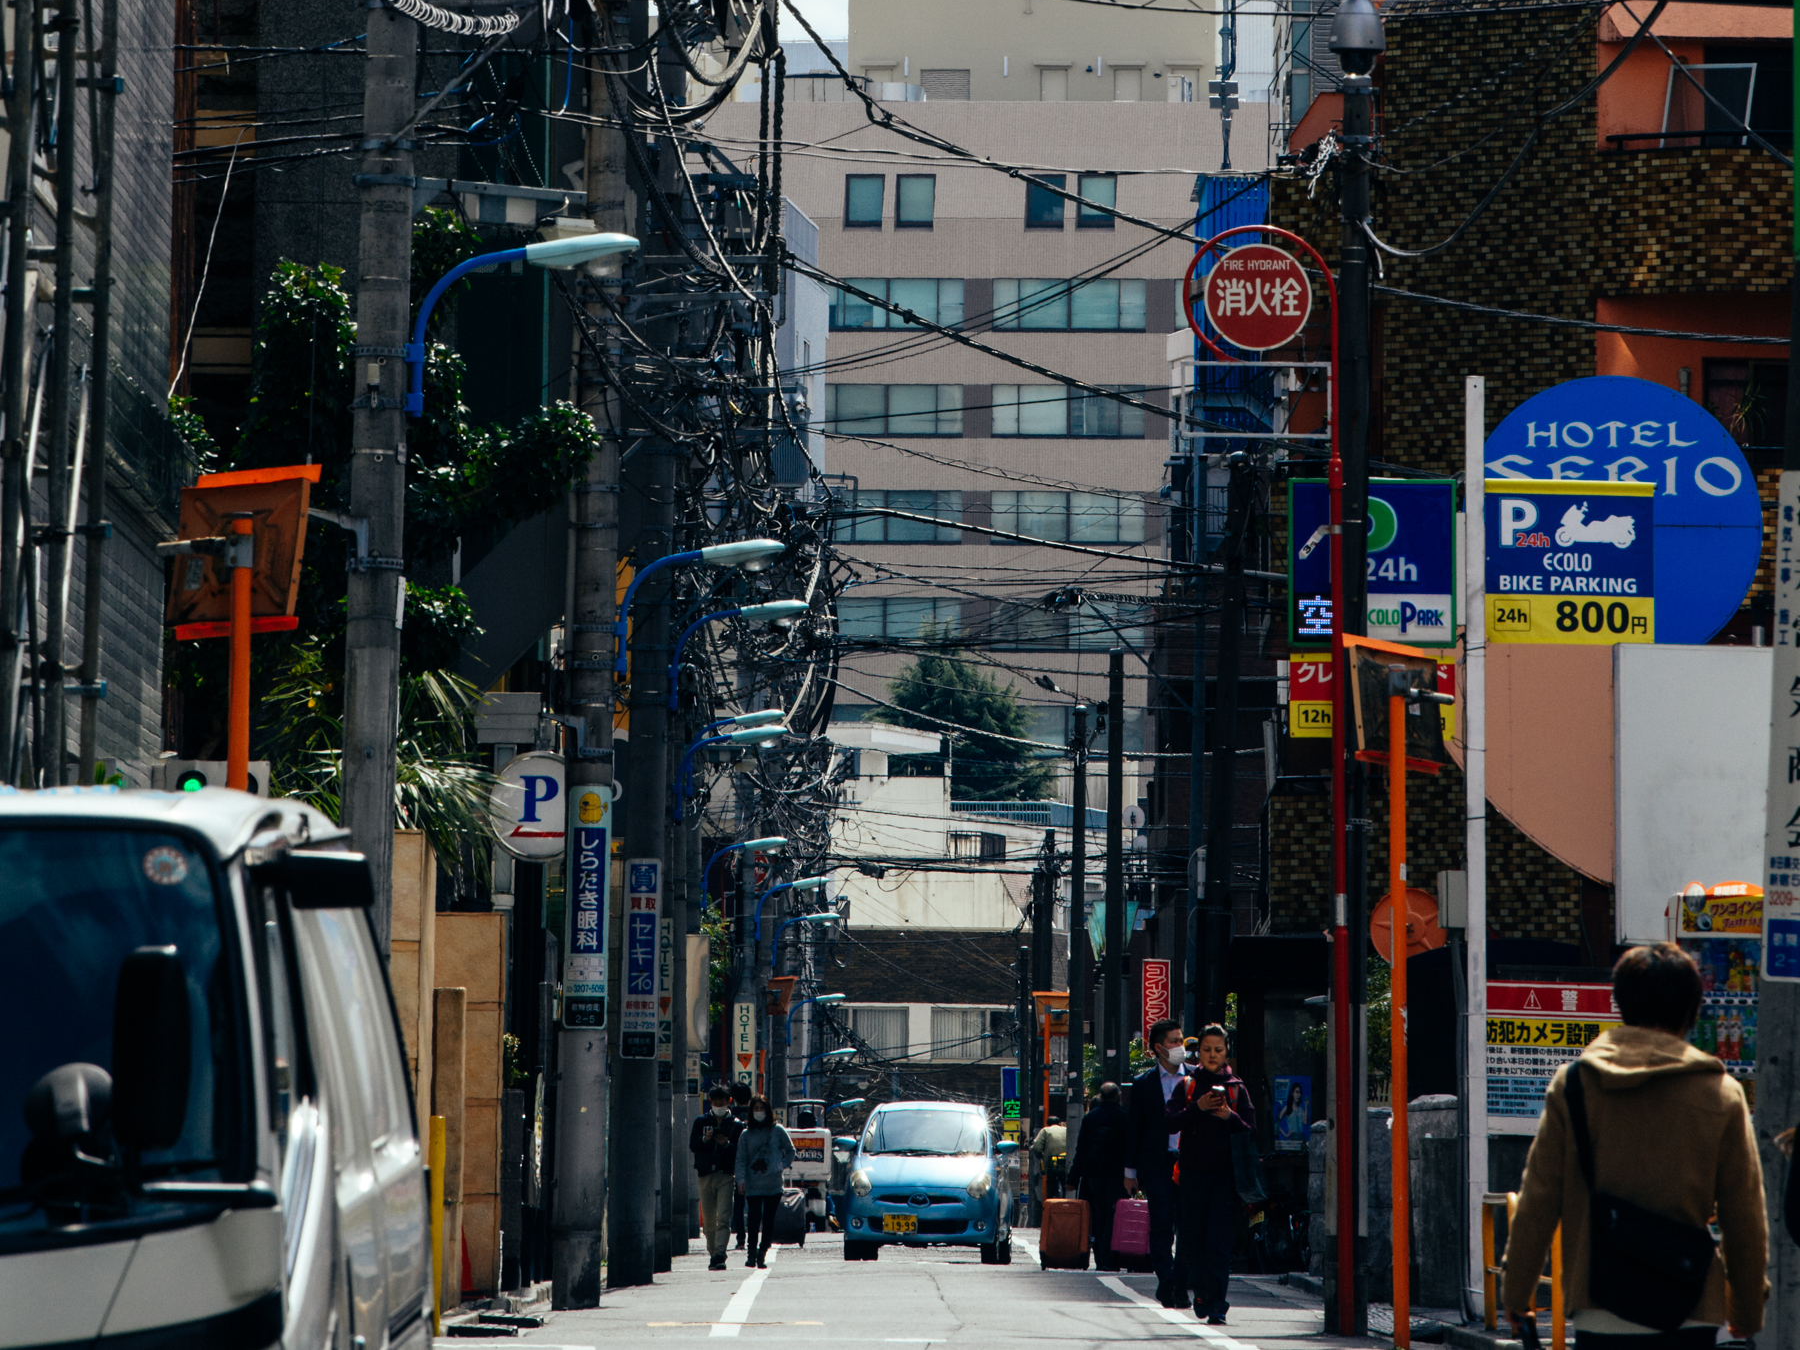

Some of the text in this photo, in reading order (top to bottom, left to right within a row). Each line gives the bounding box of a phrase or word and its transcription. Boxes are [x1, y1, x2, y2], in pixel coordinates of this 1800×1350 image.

[1223, 259, 1291, 271] FIRE HYDRANT
[1216, 277, 1302, 317] 消火栓
[1525, 420, 1699, 448] HOTEL
[1499, 499, 1537, 547] P
[1516, 532, 1550, 548] 24h
[1366, 557, 1418, 581] 24h
[1543, 553, 1592, 572] ECOLO
[1499, 574, 1638, 594] BIKE PARKING
[1299, 595, 1333, 635] 空
[1367, 601, 1446, 634] COLOPARK
[1496, 607, 1528, 625] 24h
[1556, 601, 1648, 635] 800円
[1302, 709, 1331, 723] 12h
[518, 775, 559, 822] P
[576, 830, 600, 950] しらたき眼科
[630, 897, 656, 910] 買取
[575, 1014, 595, 1024] 2-5
[740, 1005, 750, 1052] HOTEL
